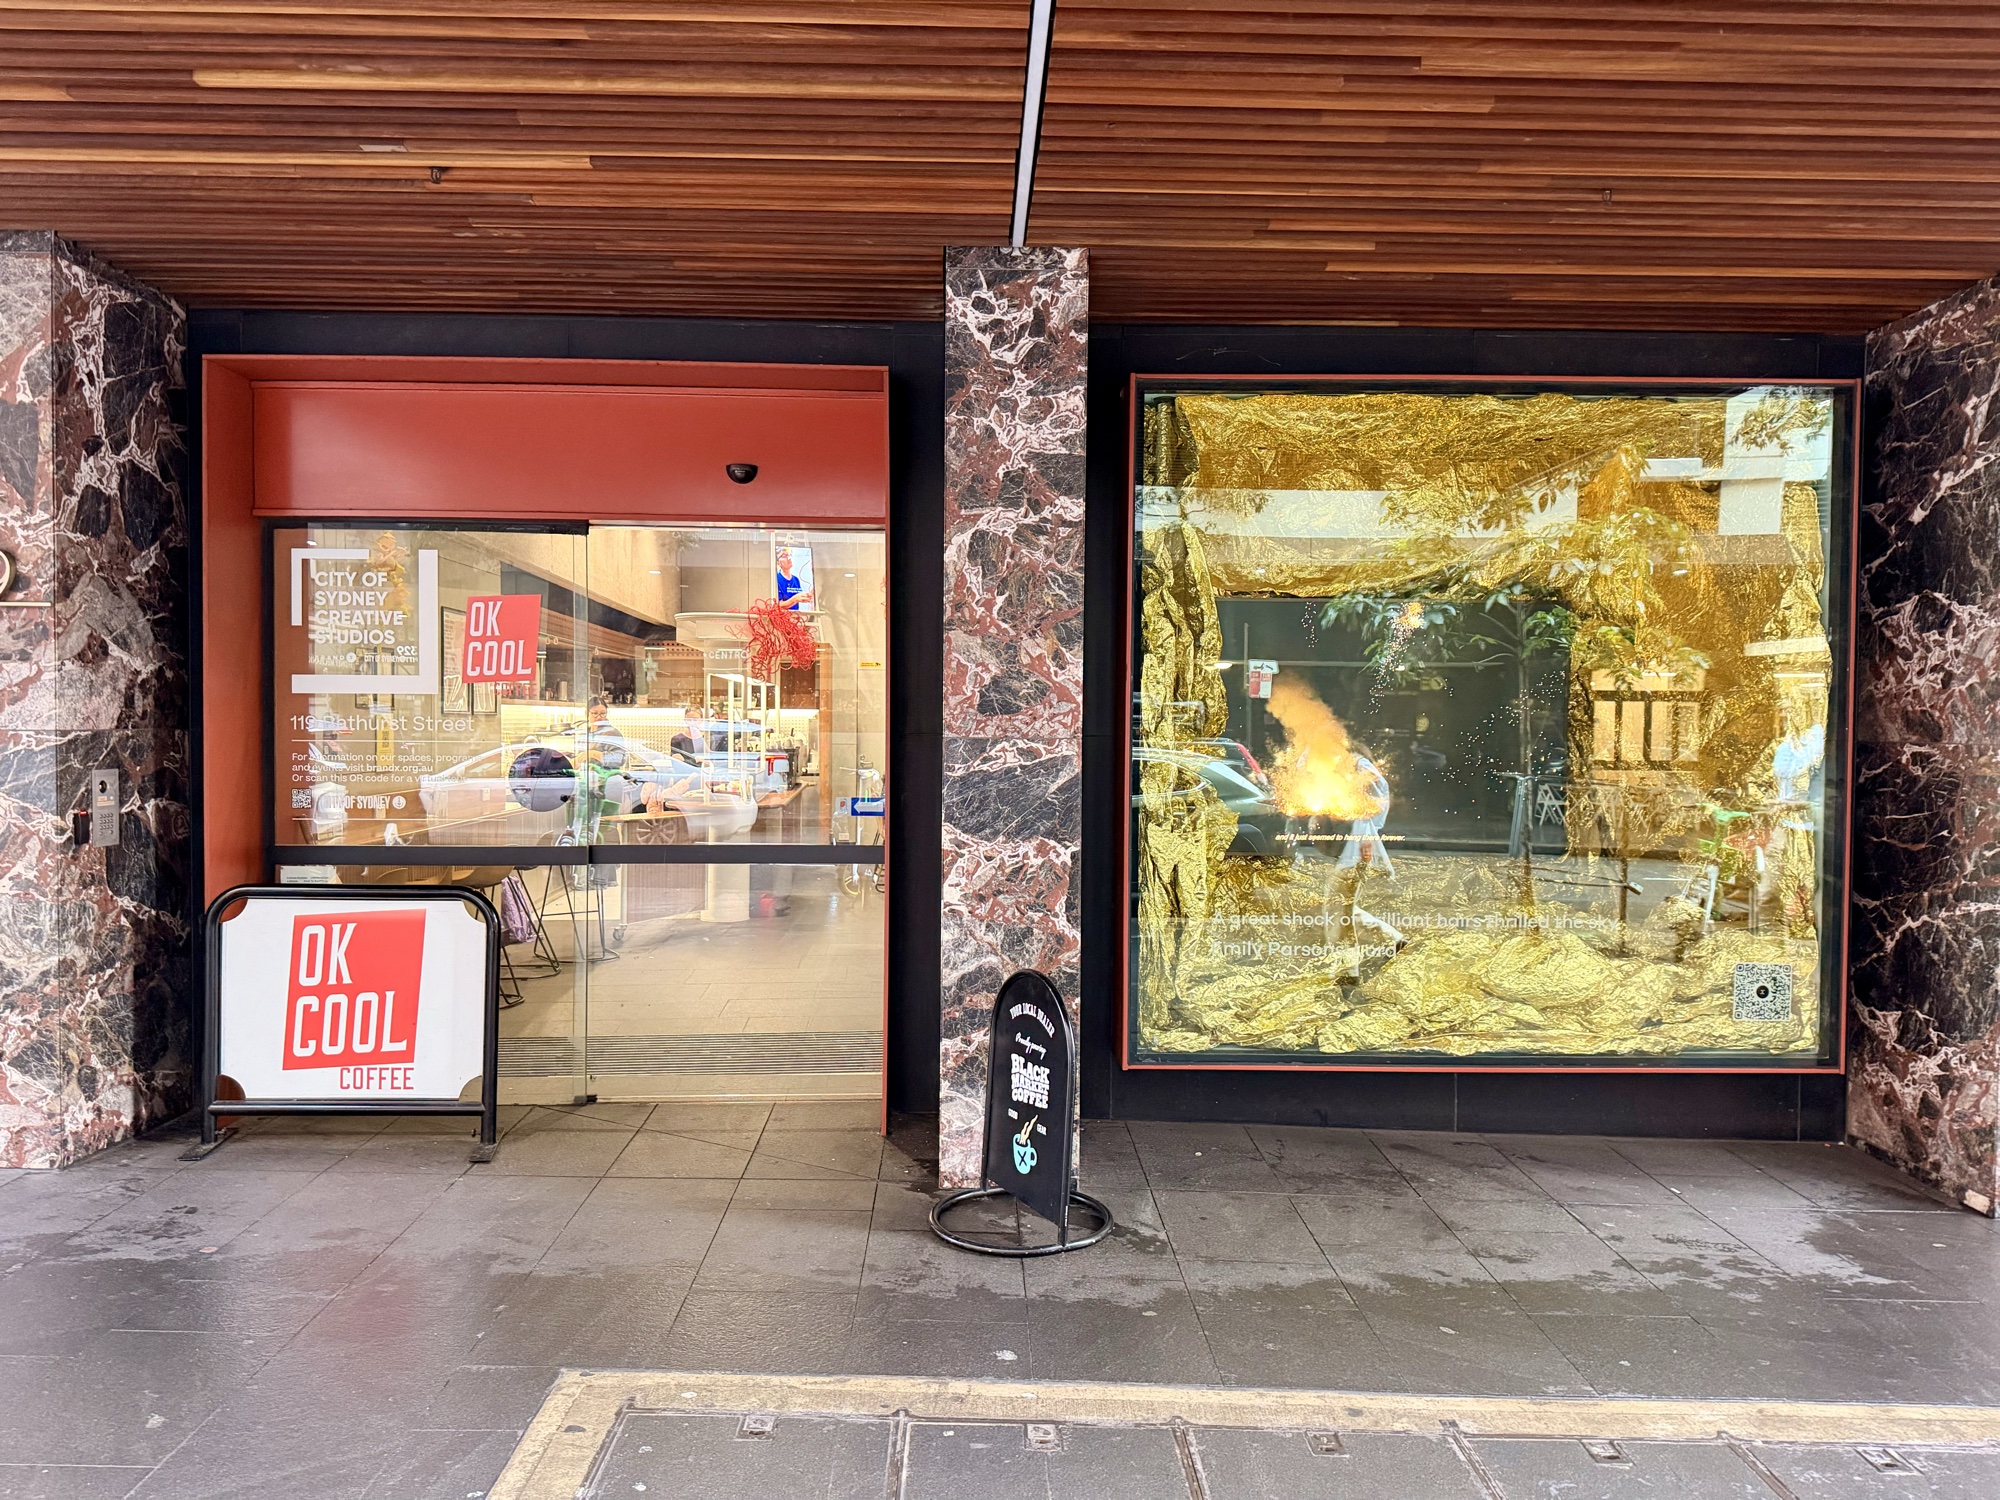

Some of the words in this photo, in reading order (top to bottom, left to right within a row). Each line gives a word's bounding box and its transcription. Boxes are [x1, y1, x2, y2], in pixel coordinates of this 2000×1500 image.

[315, 571, 357, 587] CITY
[361, 571, 388, 587] OF
[314, 590, 388, 606] SYDNEY
[315, 609, 404, 626] CREATIVE
[469, 601, 503, 637] OK
[314, 629, 396, 645] STUDIOS
[466, 640, 532, 676] COOL
[290, 714, 315, 731] 119
[323, 714, 407, 732] Bathurst
[413, 715, 475, 732] Street
[292, 752, 307, 762] For
[309, 752, 363, 762] formation
[366, 754, 377, 762] on
[380, 754, 396, 762] our
[398, 754, 434, 764] spaces,
[291, 763, 310, 772] and
[346, 763, 365, 772] visit
[366, 763, 434, 774] brandx.org.au
[292, 773, 305, 783] Or
[305, 775, 328, 783] scan
[331, 774, 348, 783] this
[349, 774, 364, 783] QR
[365, 774, 389, 783] code
[390, 774, 405, 783] for
[345, 796, 356, 809] OF
[357, 795, 391, 810] SYDNEY
[1213, 910, 1226, 926] A
[1229, 912, 1279, 930] great
[1283, 911, 1336, 927] shock
[1340, 912, 1359, 927] of
[1364, 911, 1432, 928] billiant
[1437, 912, 1482, 929] hairs
[1486, 913, 1550, 930] thrilled
[1555, 914, 1584, 930] the
[1588, 914, 1621, 932] sky
[298, 923, 357, 987] OK
[1212, 940, 1263, 960] Emily
[292, 990, 408, 1057] COOL
[339, 1067, 415, 1090] COFFEE
[1010, 1053, 1050, 1086] BLACK
[1011, 1072, 1050, 1096] MARKET
[1011, 1087, 1049, 1109] COFFEE
